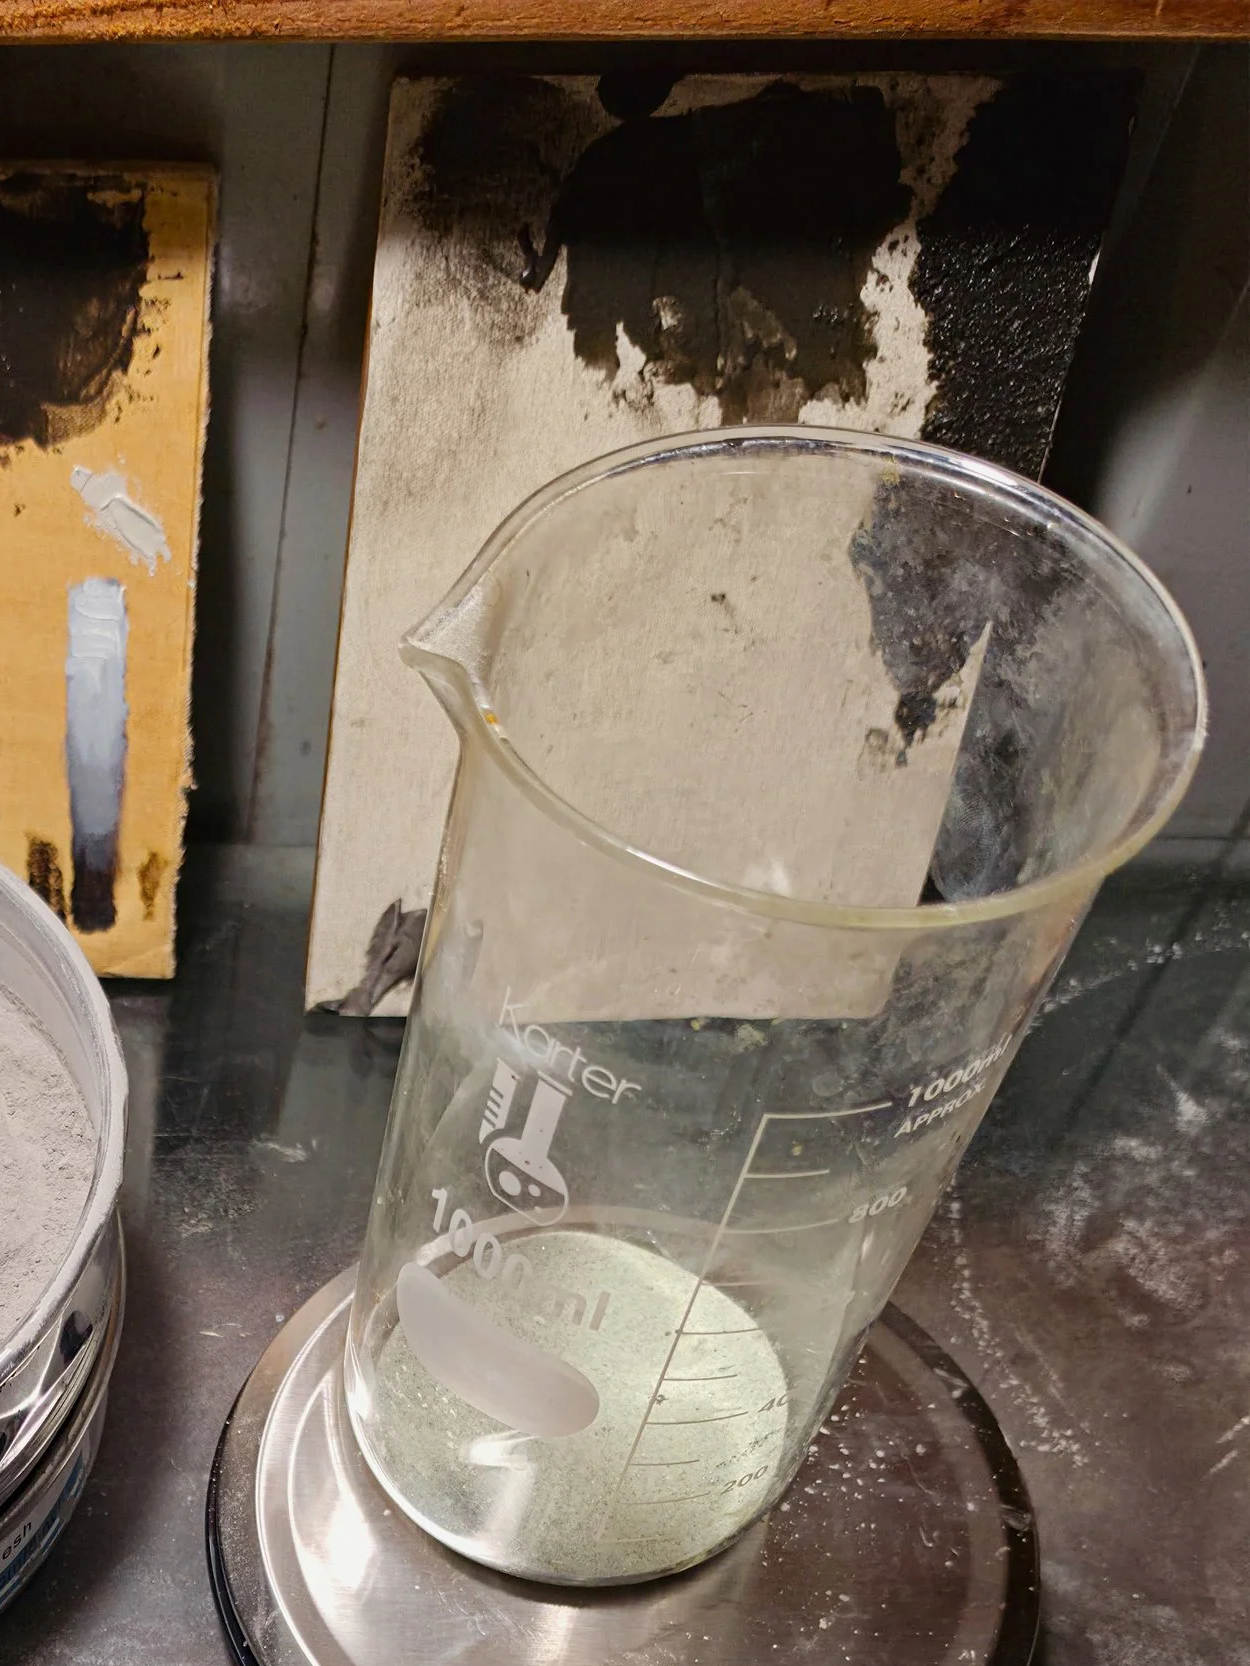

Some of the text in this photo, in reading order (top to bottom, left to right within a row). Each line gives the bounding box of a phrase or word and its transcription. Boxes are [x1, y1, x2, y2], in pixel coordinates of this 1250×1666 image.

[499, 985, 643, 1105] Karter
[907, 1034, 1013, 1108] 1000ml
[848, 1186, 908, 1225] 800
[719, 1464, 770, 1496] 200
